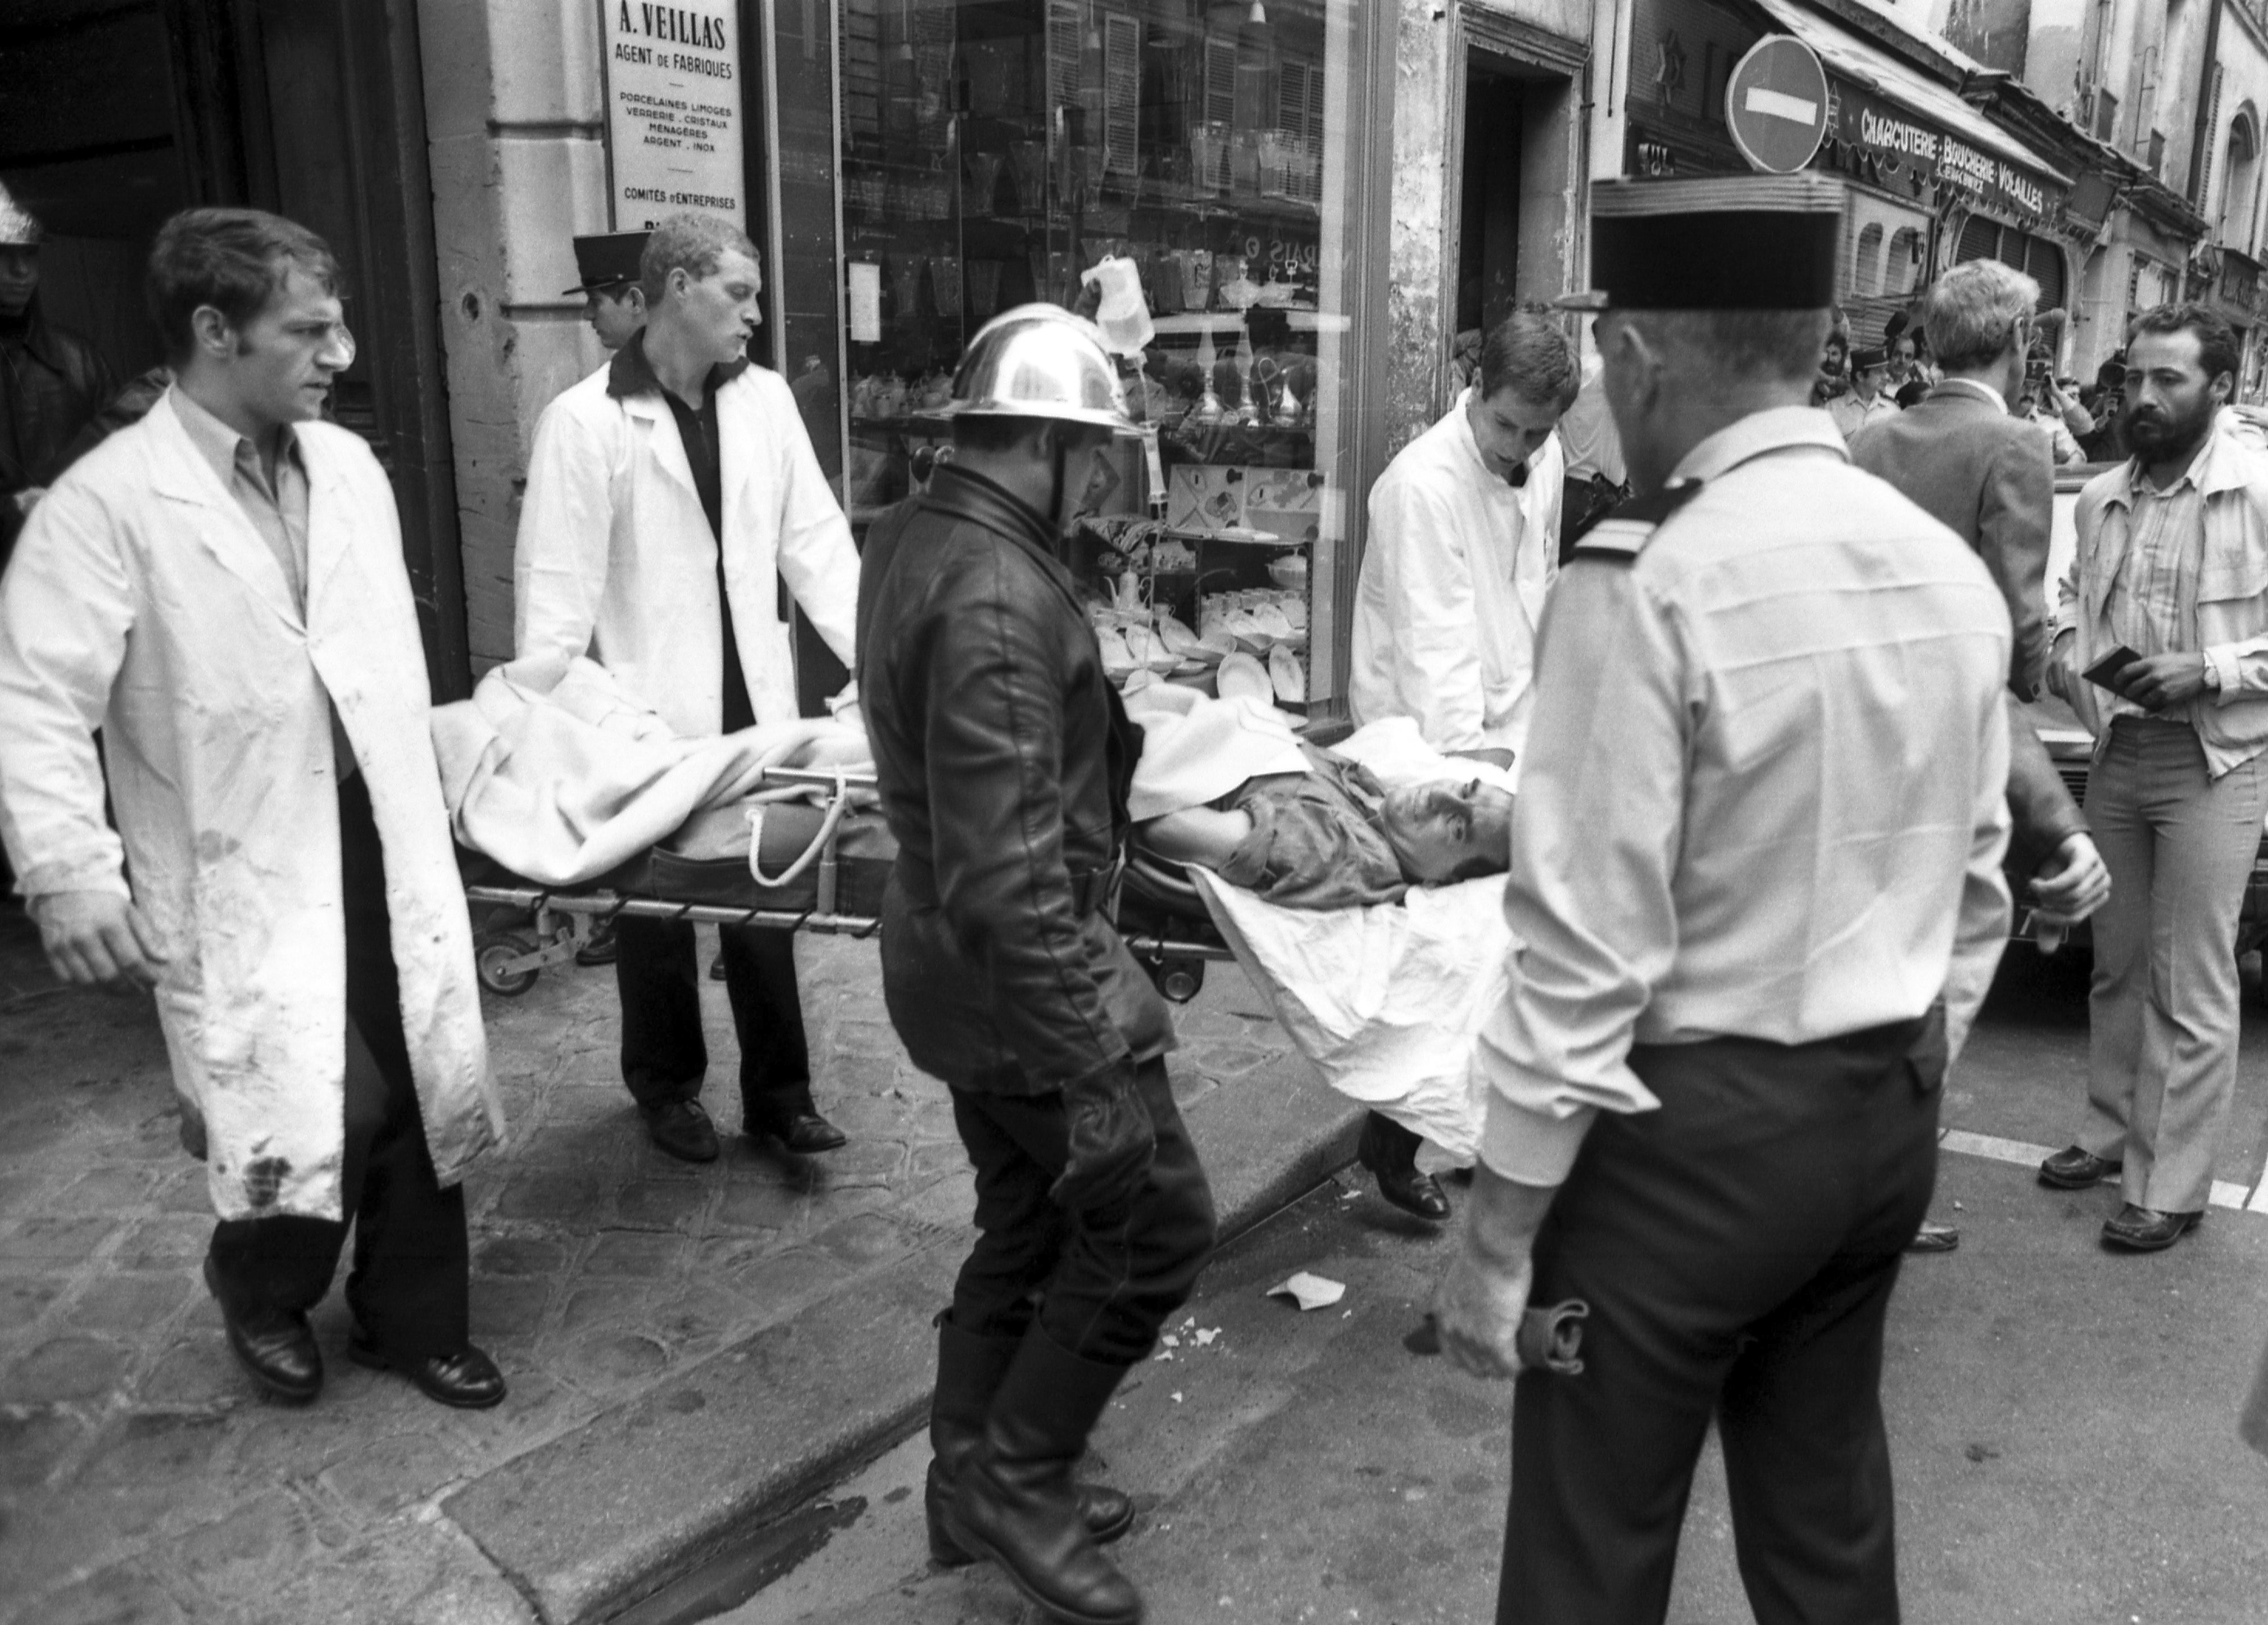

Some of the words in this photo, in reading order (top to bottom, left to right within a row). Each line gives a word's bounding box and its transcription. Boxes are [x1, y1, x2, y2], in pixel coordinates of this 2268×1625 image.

[620, 0, 637, 33] A.
[642, 3, 725, 51] VEILLAS
[616, 43, 652, 64] AGENT
[657, 55, 669, 68] DE
[674, 53, 732, 79] FABRIQUES
[620, 92, 688, 110] PORCELAINES
[691, 103, 731, 117] LIMOGES
[627, 107, 674, 121] VERRERIE
[684, 115, 727, 129] CRISTAUX
[643, 136, 682, 148] ARGENT
[693, 143, 715, 152] INOX
[1861, 108, 1937, 160] CHARCUTERIE
[1944, 135, 1994, 184] BOUCHERIE
[1998, 162, 2042, 214] VOLAILLES
